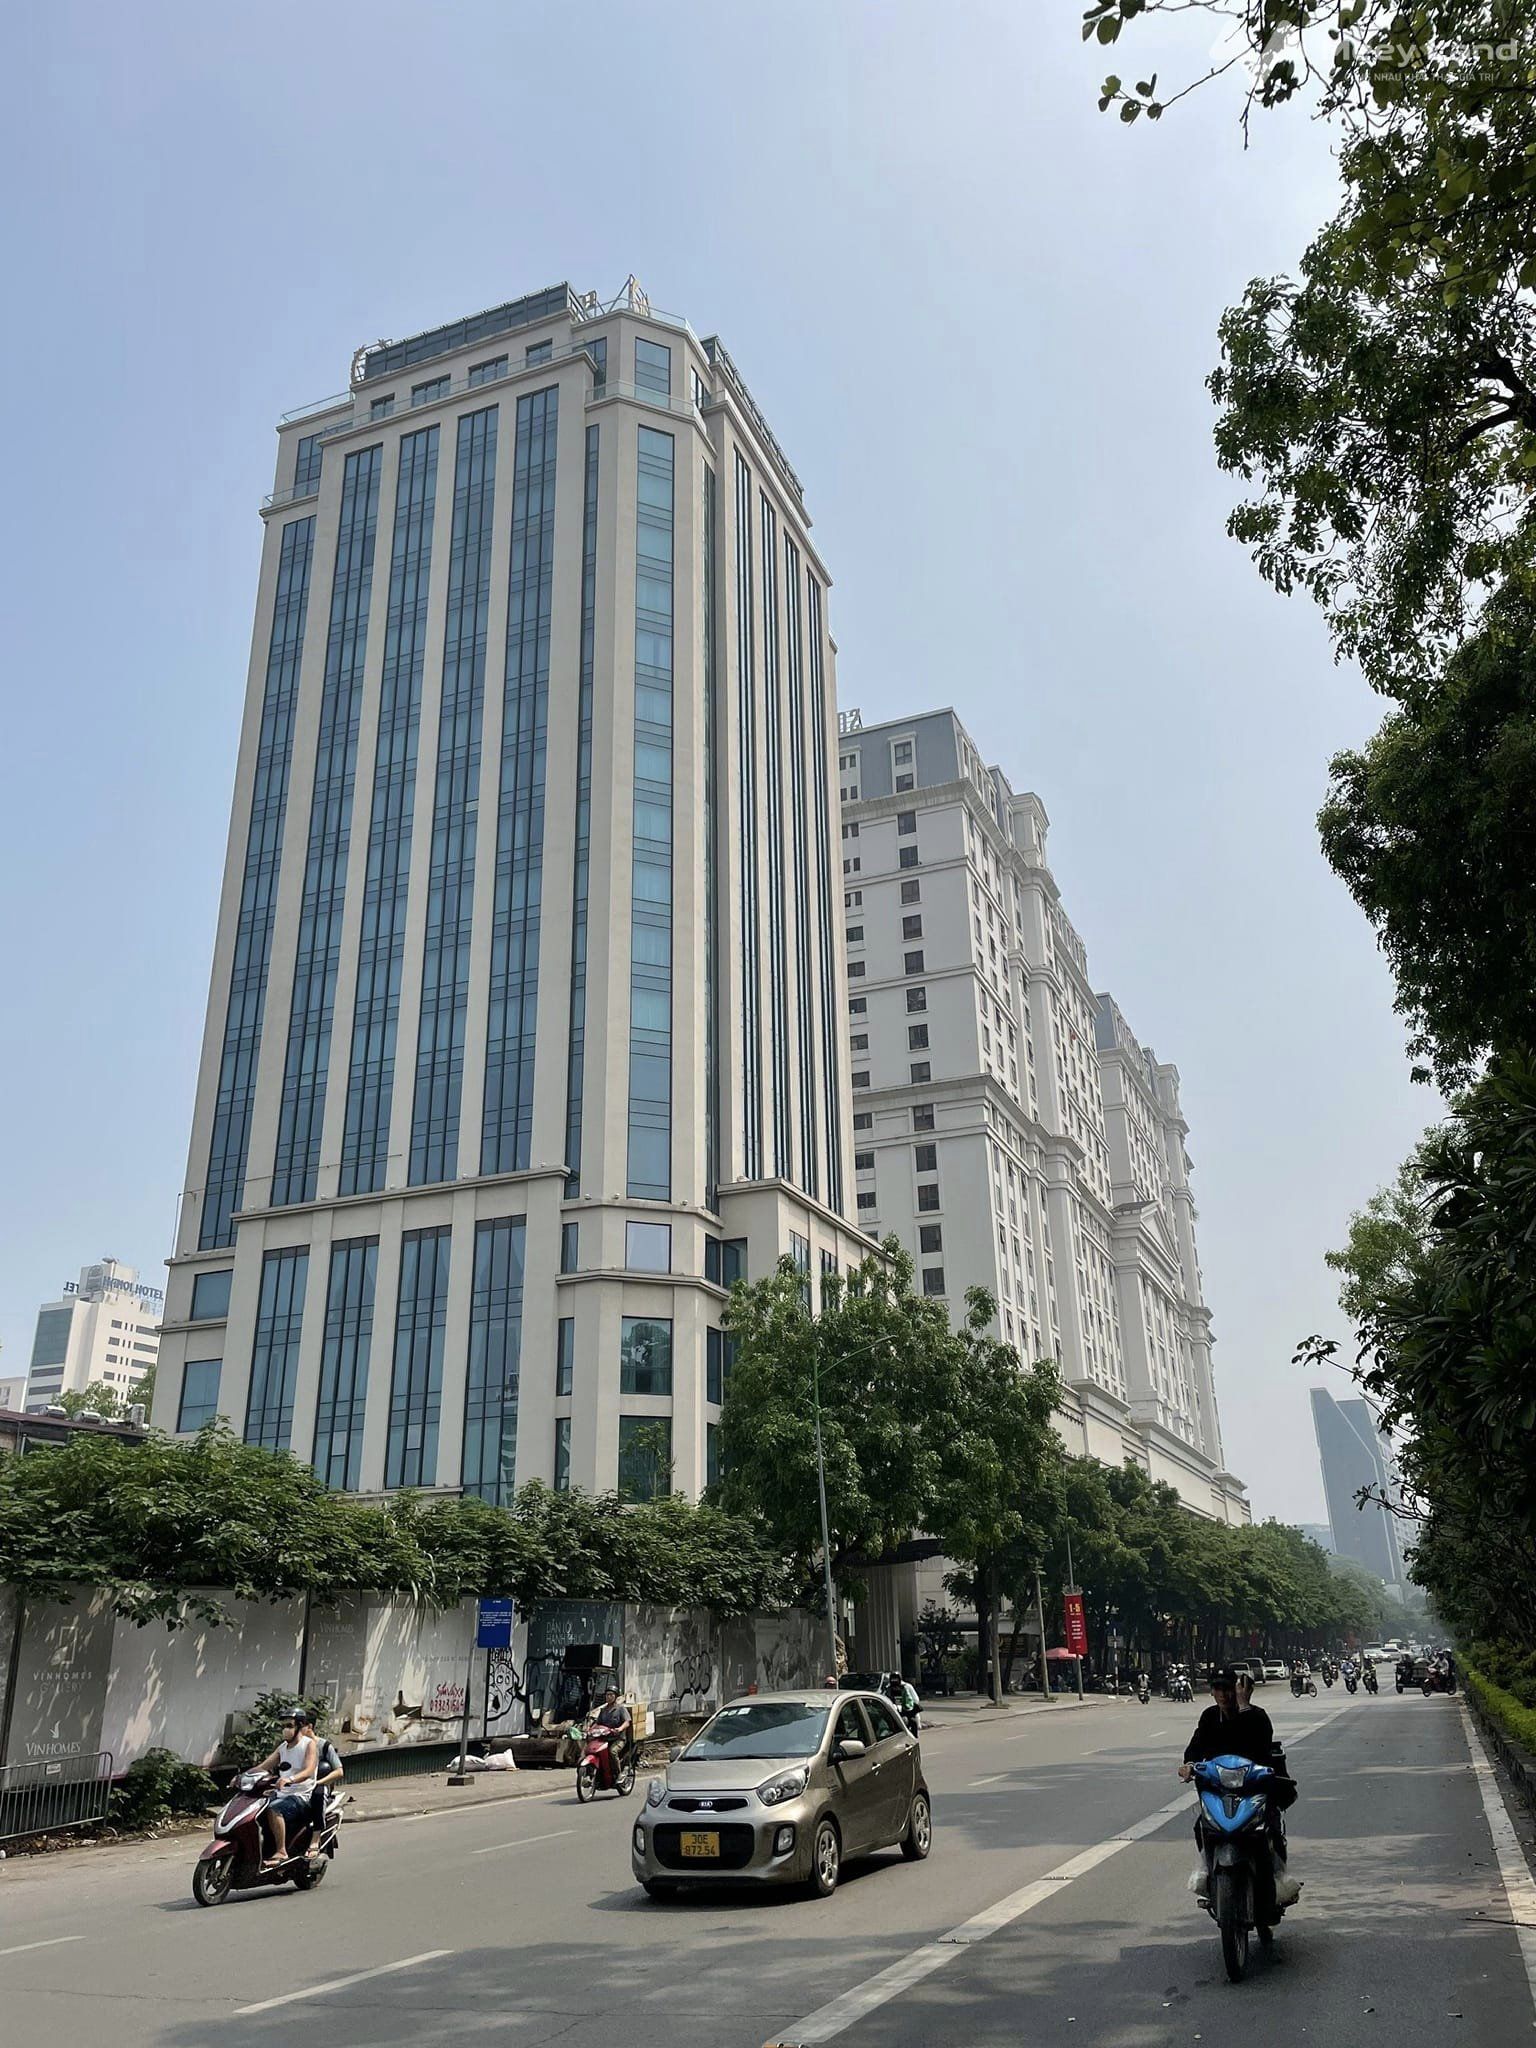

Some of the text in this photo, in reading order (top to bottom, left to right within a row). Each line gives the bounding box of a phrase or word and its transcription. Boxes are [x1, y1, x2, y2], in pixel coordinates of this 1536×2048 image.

[135, 1283, 164, 1300] HOTEL
[33, 1671, 92, 1681] VINHOMES
[40, 1682, 82, 1693] GALERY
[26, 1741, 81, 1756] VINHOMES
[692, 1834, 708, 1844] 30E
